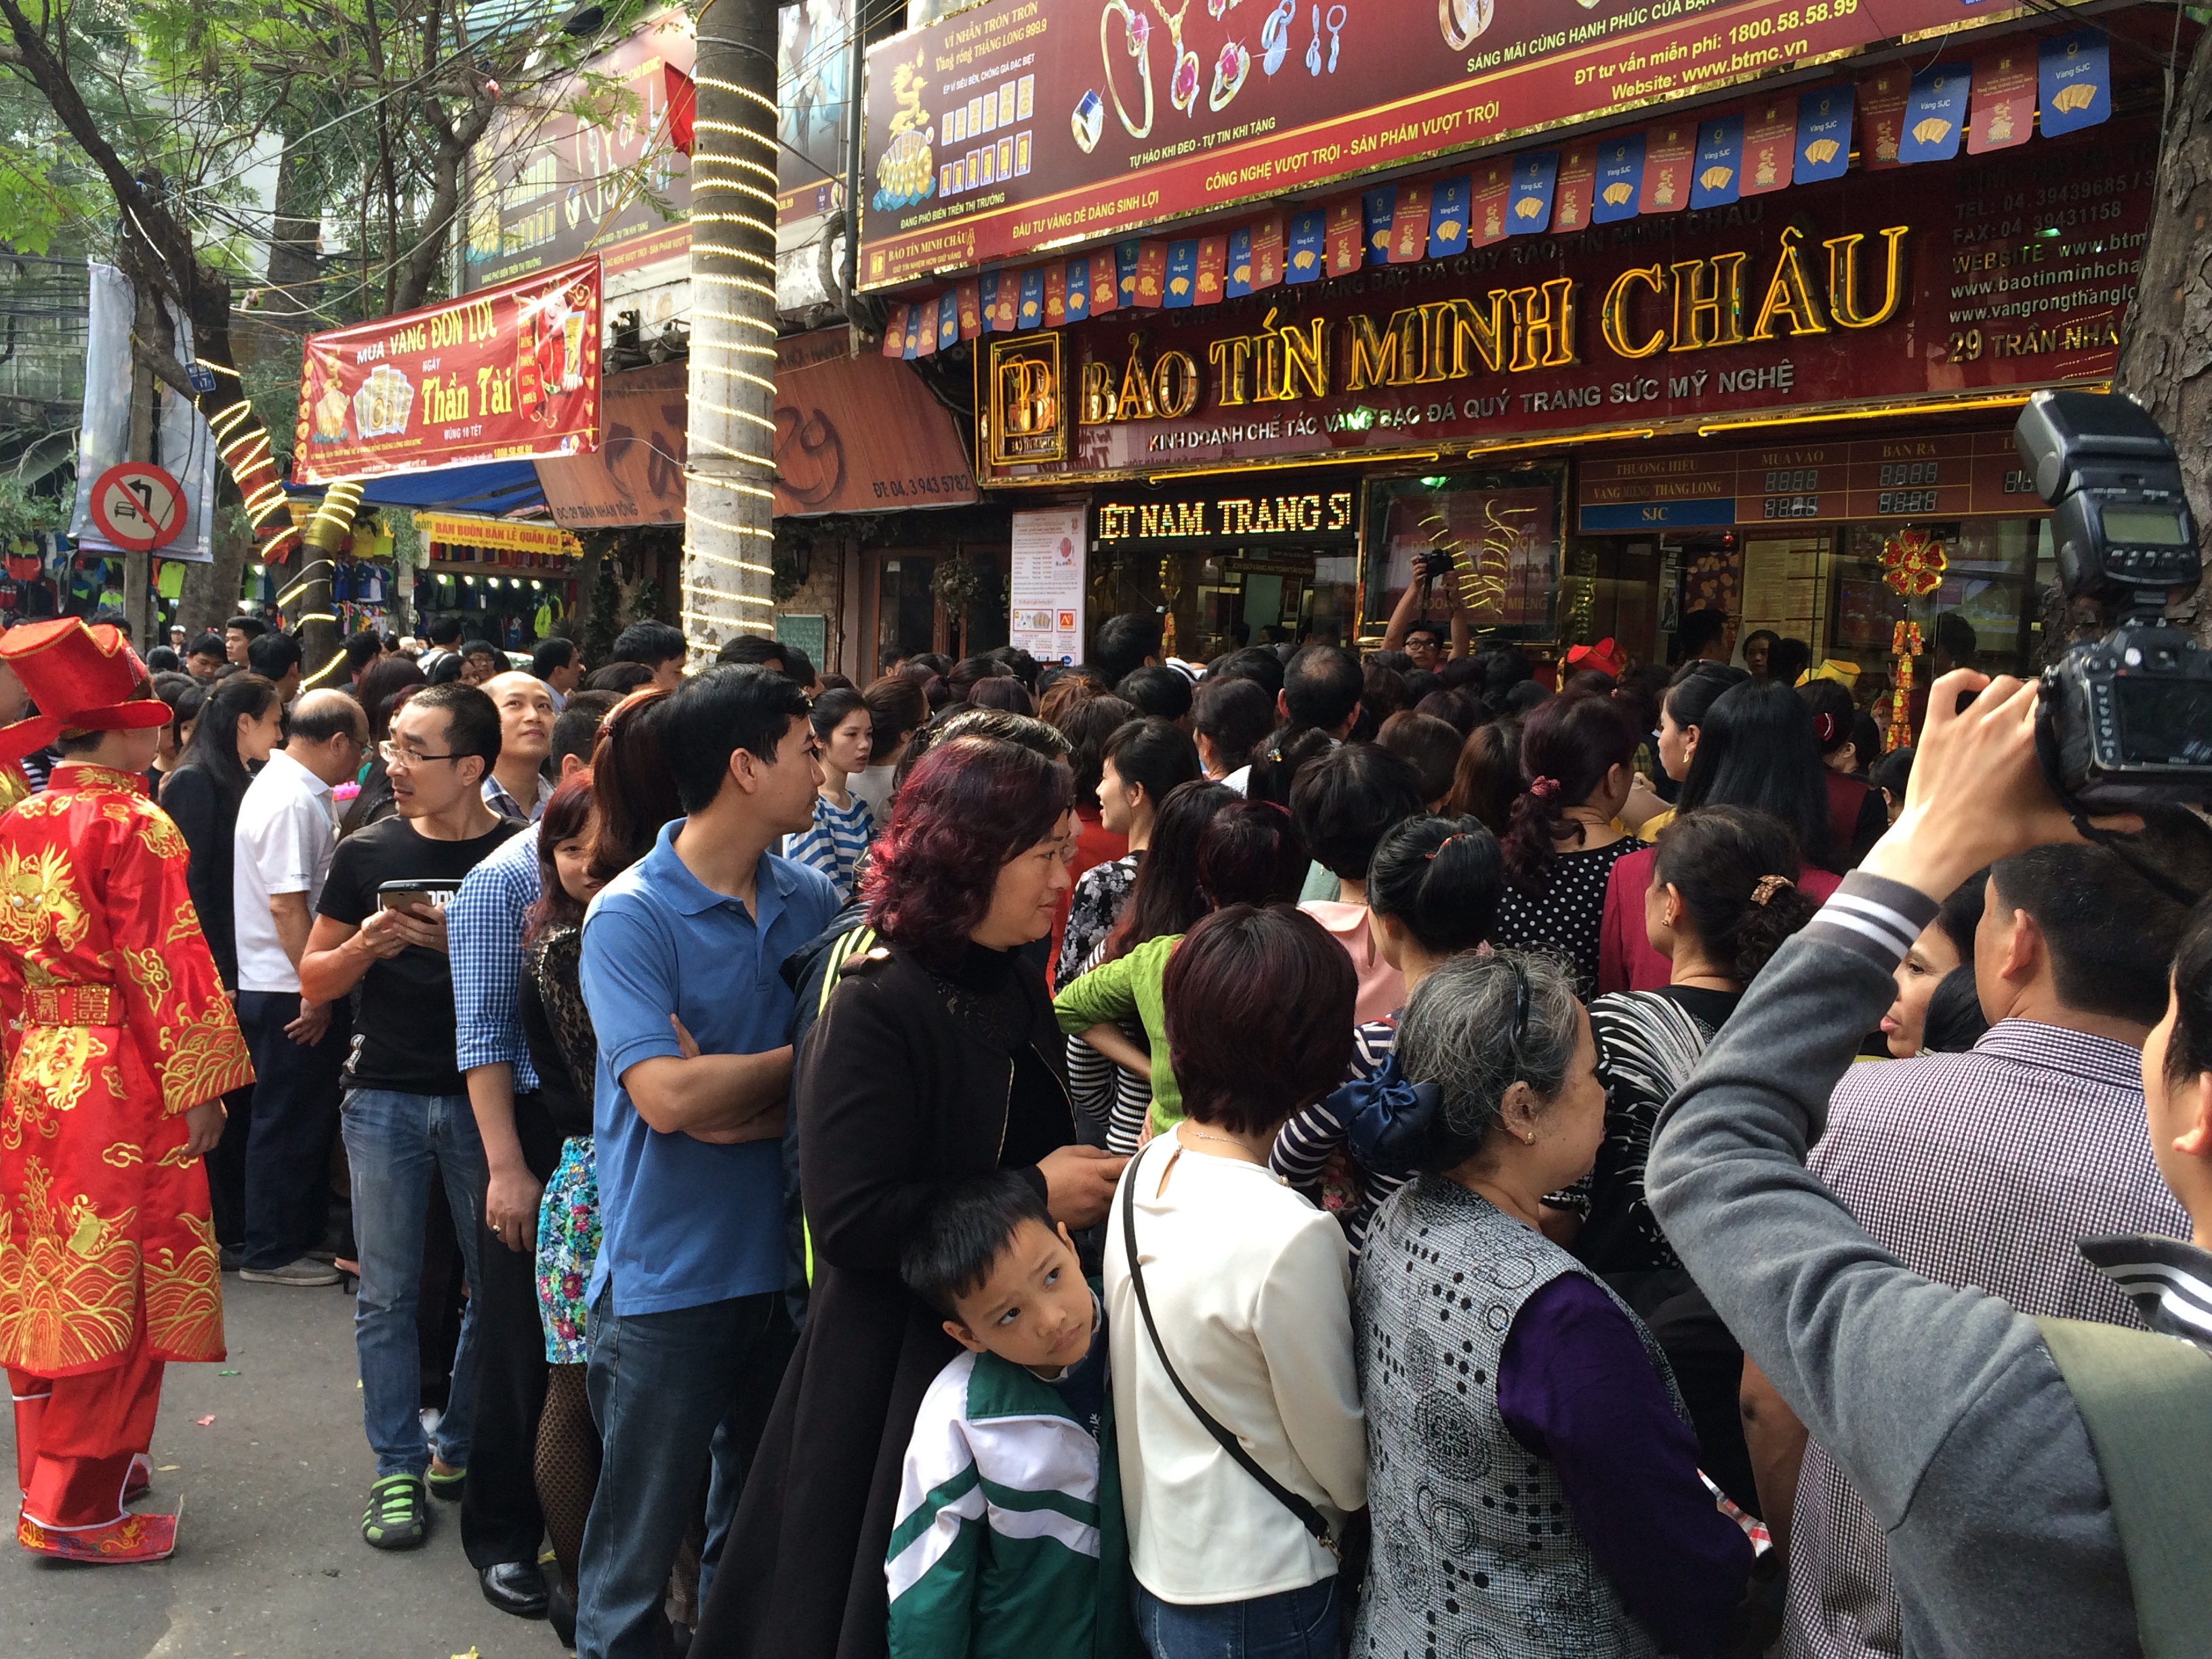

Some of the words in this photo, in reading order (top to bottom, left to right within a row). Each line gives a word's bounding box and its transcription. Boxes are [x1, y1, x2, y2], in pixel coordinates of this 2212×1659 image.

[983, 13, 1009, 34] TRÒN
[1011, 1, 1038, 23] TRƠN
[1003, 28, 1025, 47] LONG
[1025, 18, 1048, 39] 999.9
[1467, 51, 1500, 73] SÁNG
[1504, 41, 1525, 62] MÃI
[1529, 33, 1565, 54] CÙNG
[1569, 20, 1606, 44] HẠNH
[1610, 6, 1647, 32] PHÚC
[1574, 66, 1595, 86] ĐT
[1599, 64, 1616, 79] tư
[1619, 51, 1645, 74] vấn
[1650, 41, 1687, 66] miễn
[1692, 33, 1722, 59] phí:
[1728, 0, 1858, 45] 1800.58.58.99
[1612, 73, 1677, 101] Website:
[1681, 39, 1808, 84] www.btmc.vn
[1130, 155, 1142, 168] TỰ
[1143, 148, 1160, 165] HÀO
[1162, 144, 1176, 159] KHI
[1177, 139, 1195, 155] ĐEO
[1202, 134, 1216, 148] TỰ
[1217, 130, 1231, 142] TIN
[1233, 125, 1249, 140] KHI
[1250, 117, 1276, 136] TẶNG
[1205, 169, 1237, 192] CÔNG
[1240, 161, 1272, 184] NGHỆ
[1274, 151, 1309, 175] VƯỢT
[1312, 142, 1340, 166] TRỘI
[1351, 134, 1377, 156] SẢN
[1380, 121, 1419, 149] PHẨM
[1422, 110, 1462, 138] VƯỢT
[1466, 100, 1500, 127] TRỘI
[2036, 175, 2127, 205] 39439685
[901, 218, 918, 230] ĐANG
[932, 207, 947, 222] BIẾN
[947, 201, 964, 217] TRÊN
[965, 201, 976, 213] THỊ
[977, 192, 1005, 209] TRƯỜNG
[1012, 220, 1031, 239] ĐẦU
[1032, 218, 1046, 233] TƯ
[1046, 211, 1072, 232] VÀNG
[1074, 205, 1086, 224] DỄ
[1088, 199, 1115, 220] DÀNG
[1117, 197, 1140, 214] SINH
[1142, 190, 1160, 209] LỢI
[2032, 200, 2123, 230] 39431158
[888, 245, 905, 262] BẢO
[905, 240, 919, 256] TÍN
[920, 237, 943, 253] MINH
[944, 230, 968, 248] CHÂU
[1952, 244, 2045, 274] WEBSITE
[1080, 332, 1198, 425] BẢO
[1210, 306, 1328, 407] TÍN
[1346, 277, 1575, 391] MINH
[1601, 225, 1909, 358] CHÂU
[1946, 328, 1982, 364] 29
[1990, 321, 2057, 358] TRẦN
[356, 340, 385, 365] MUA
[389, 322, 426, 356] VÀNG
[422, 357, 441, 373] NGÀY
[522, 374, 535, 386] LONG
[422, 370, 470, 425] Thần
[477, 364, 512, 417] Tài
[1149, 430, 1185, 451] KINH
[1187, 424, 1243, 450] DOANH
[1246, 413, 1281, 441] CHẾ
[1286, 411, 1318, 438] TÁC
[1324, 407, 1373, 434] VÀNG
[1378, 405, 1421, 431] BẠC
[1427, 399, 1458, 423] ĐÁ
[1465, 386, 1509, 420] QUÝ
[1521, 386, 1601, 413] TRANG
[1609, 372, 1660, 405] SỨC
[1668, 368, 1709, 398] MỸ
[1717, 357, 1795, 395] NGHỆ
[462, 425, 470, 438] 10
[1762, 453, 1791, 466] MUA
[1916, 442, 1938, 456] RA
[911, 480, 920, 495] 3
[921, 478, 941, 495] 943
[942, 474, 970, 492] 5782
[1692, 479, 1722, 495] LONG
[1217, 494, 1321, 534] TRANG
[1641, 506, 1669, 522] SJC
